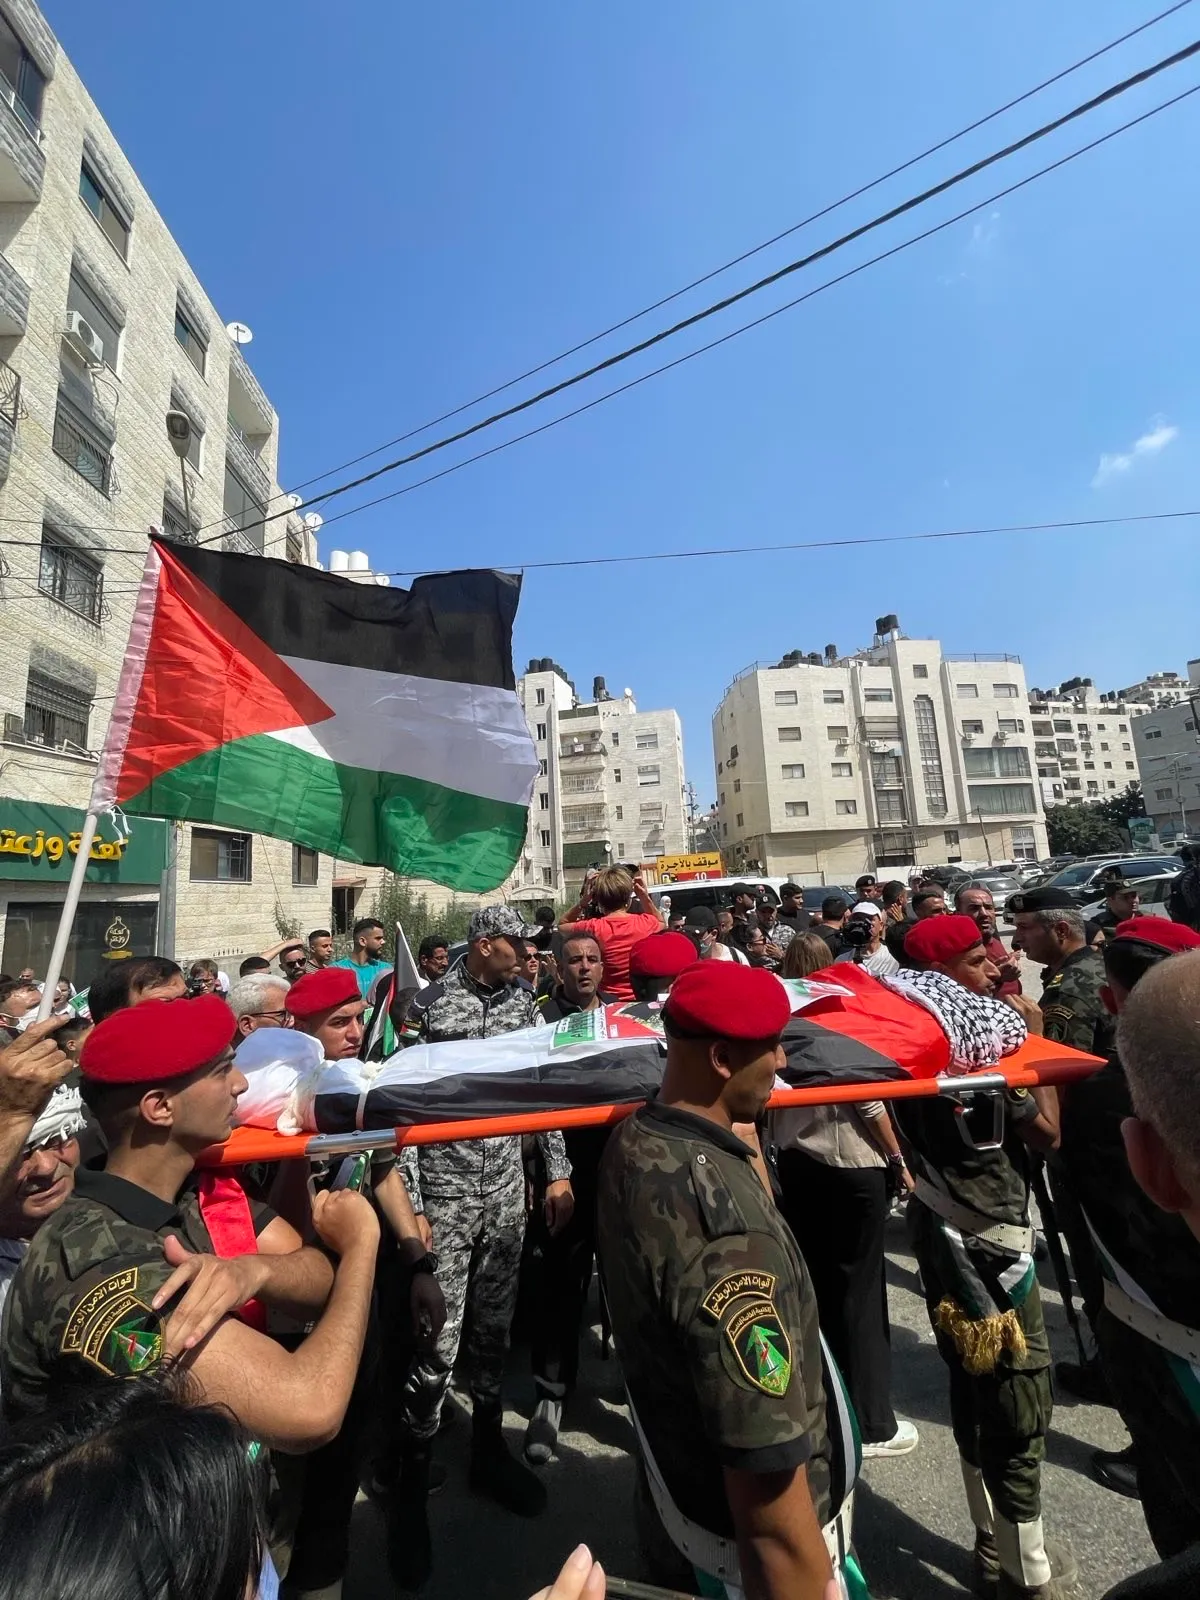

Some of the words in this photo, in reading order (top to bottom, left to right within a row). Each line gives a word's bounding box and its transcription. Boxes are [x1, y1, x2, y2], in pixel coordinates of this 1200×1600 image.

[0, 829, 64, 861] وزعت
[692, 856, 719, 868] موقف
[694, 872, 707, 881] 10
[108, 1272, 132, 1291] قوات
[752, 1276, 771, 1290] قوات
[711, 1281, 734, 1313] الوطني
